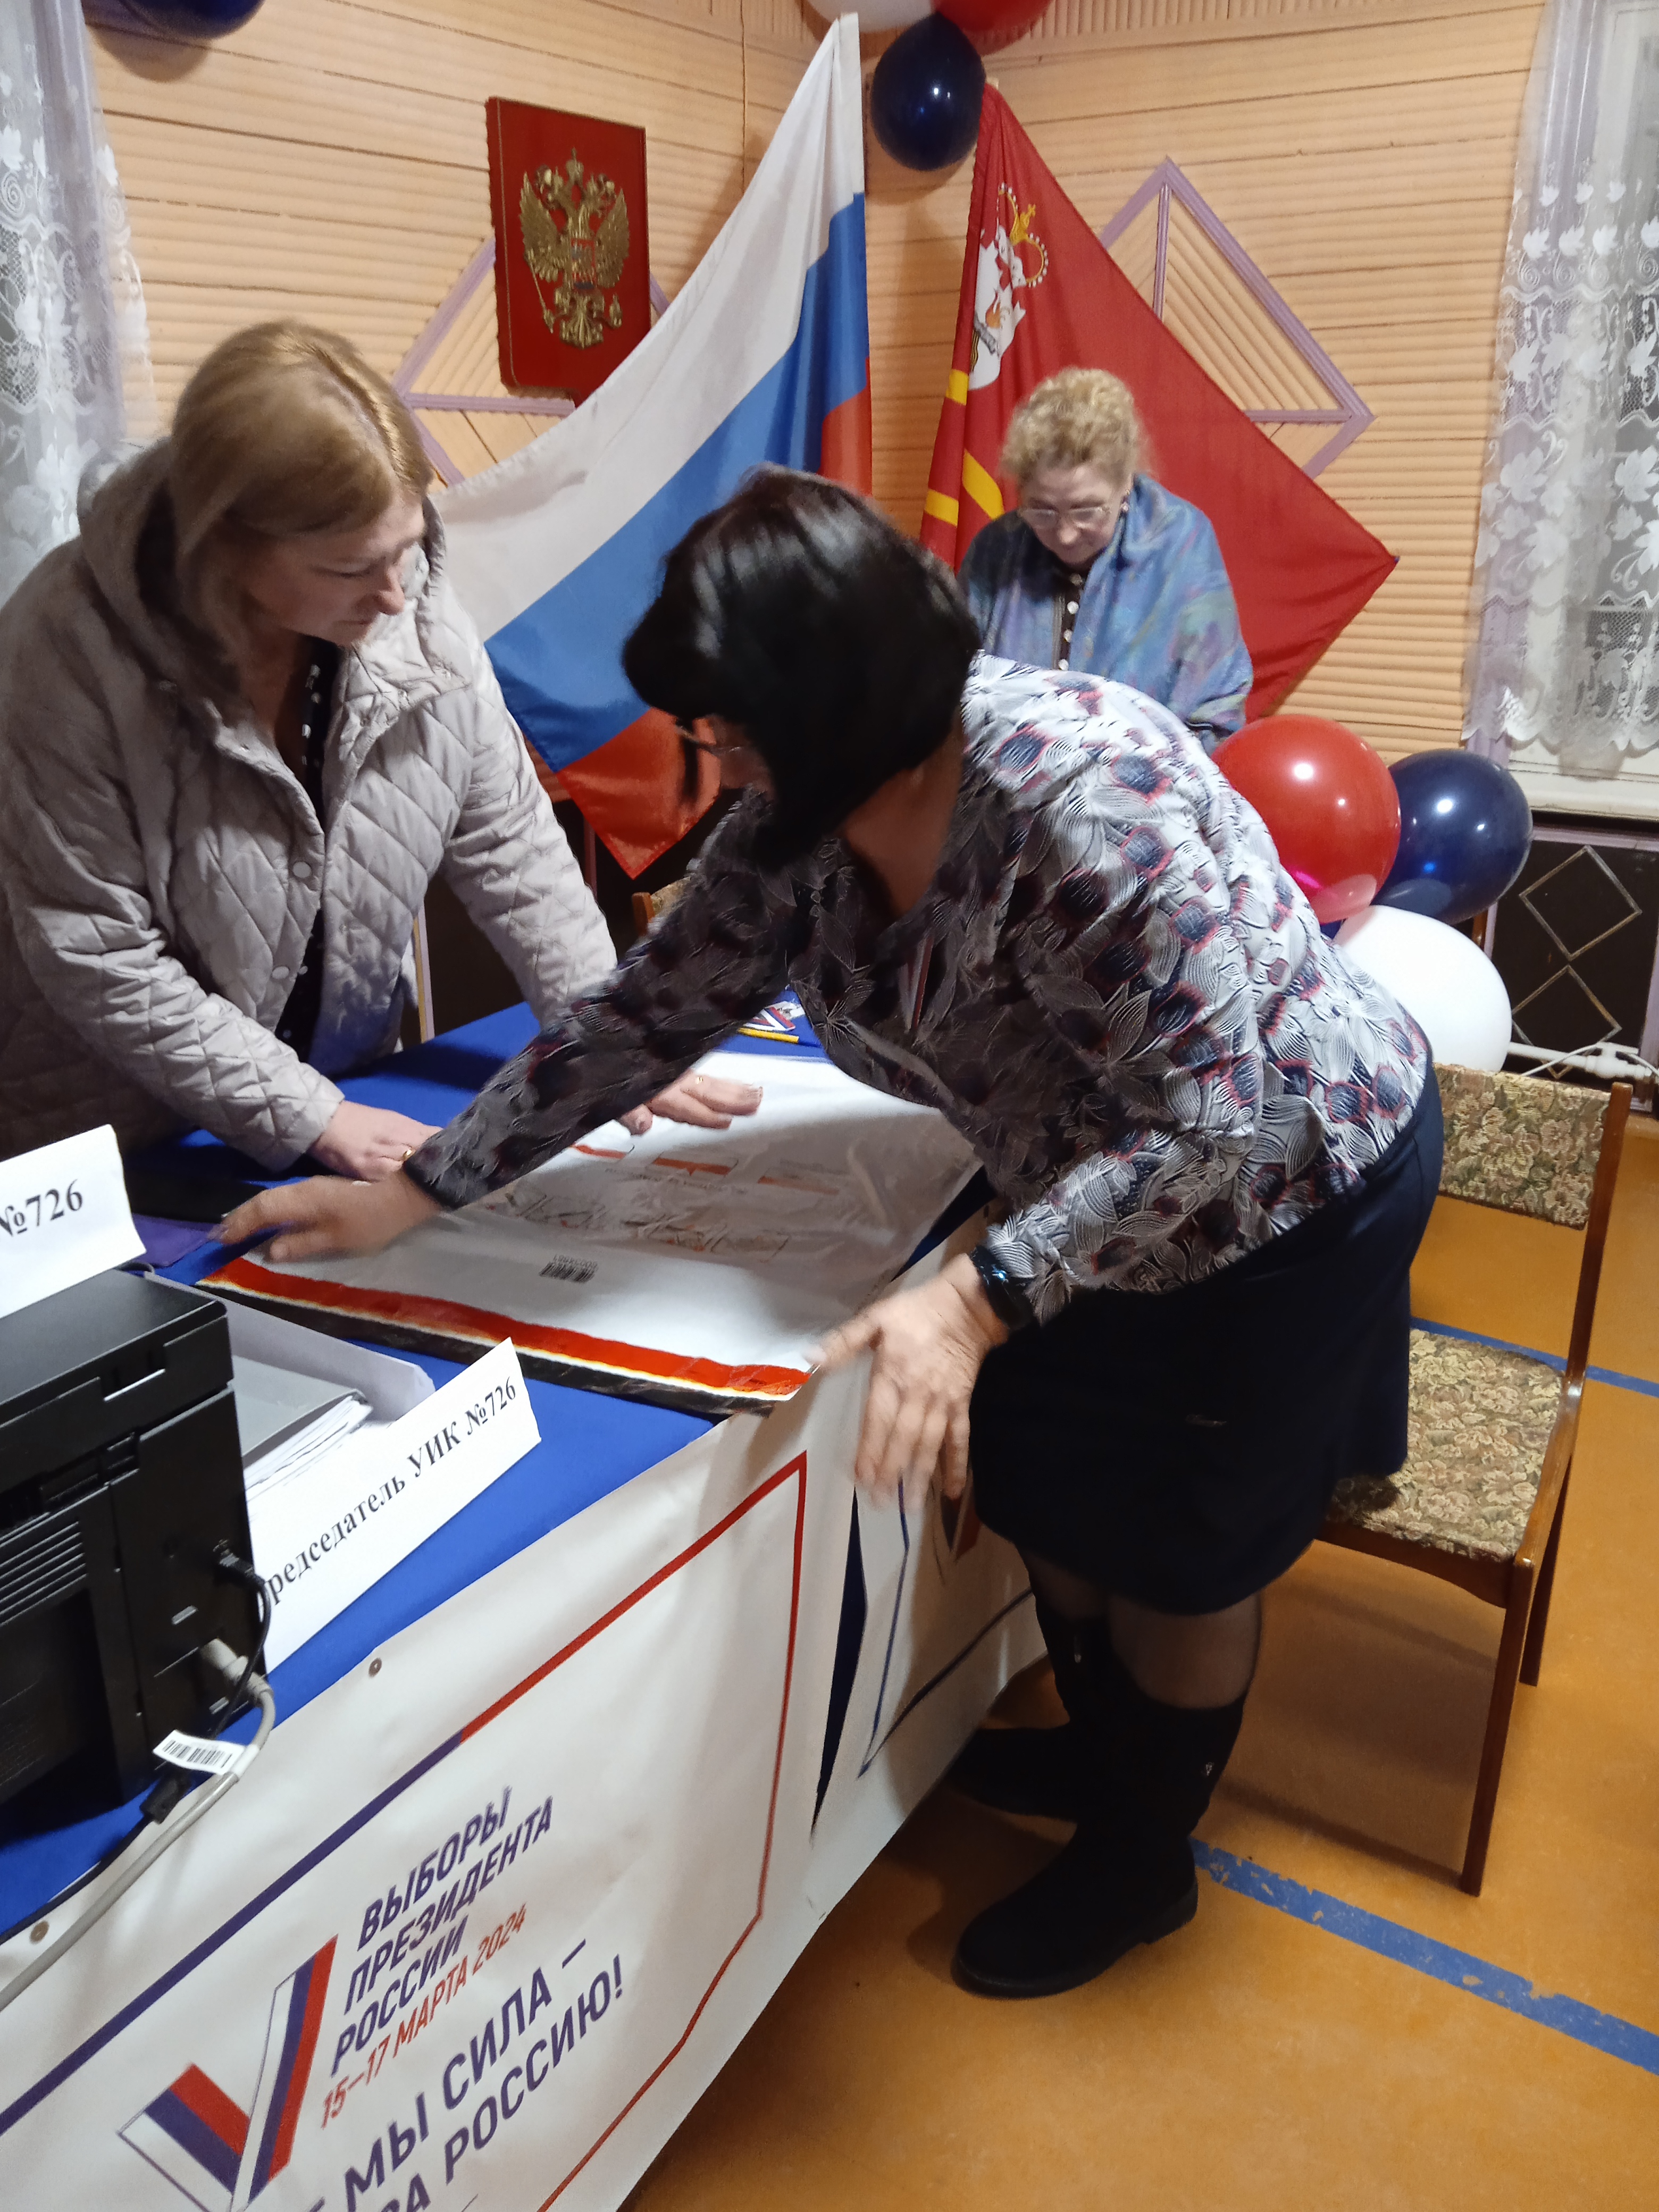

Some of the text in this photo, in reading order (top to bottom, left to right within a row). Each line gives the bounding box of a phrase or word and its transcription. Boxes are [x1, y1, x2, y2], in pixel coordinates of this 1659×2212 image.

[264, 1376, 516, 1605] редседатель УИК №726
[344, 1796, 554, 2014] ПРЕЗИДЕНТА
[357, 1785, 513, 1951] ВЫБОРЫ
[330, 1915, 468, 2077] РОССИИ
[343, 2091, 430, 2212] МЫ
[443, 1966, 552, 2110] СИЛА
[393, 1958, 468, 2059] МАРТА
[471, 1903, 529, 1976] 2024
[445, 1954, 624, 2184] РОССИЮ!
